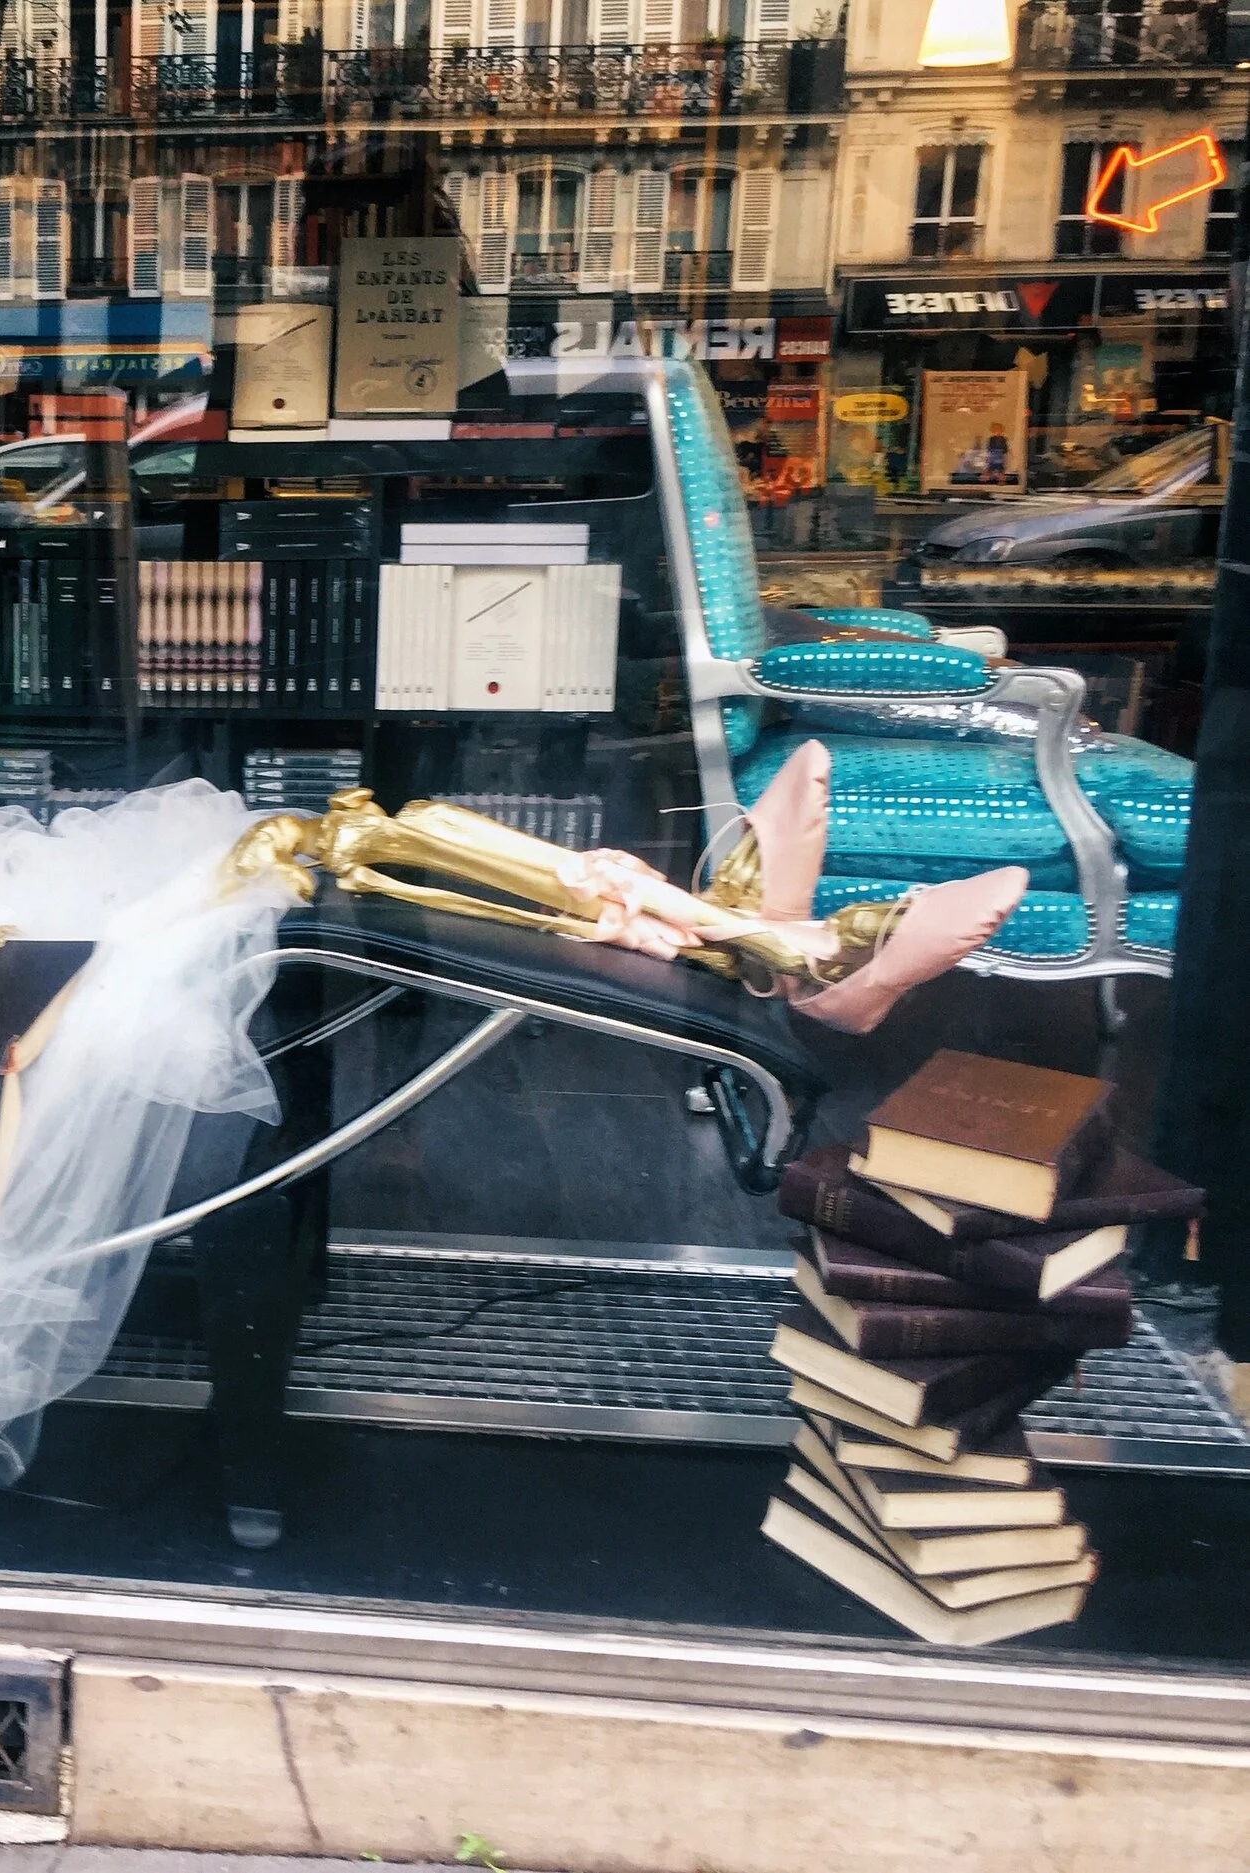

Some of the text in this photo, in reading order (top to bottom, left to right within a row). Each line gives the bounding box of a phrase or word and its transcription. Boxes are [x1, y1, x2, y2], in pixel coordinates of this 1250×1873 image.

[382, 251, 422, 266] LES
[355, 270, 448, 286] ENFANTS
[387, 289, 414, 305] DE
